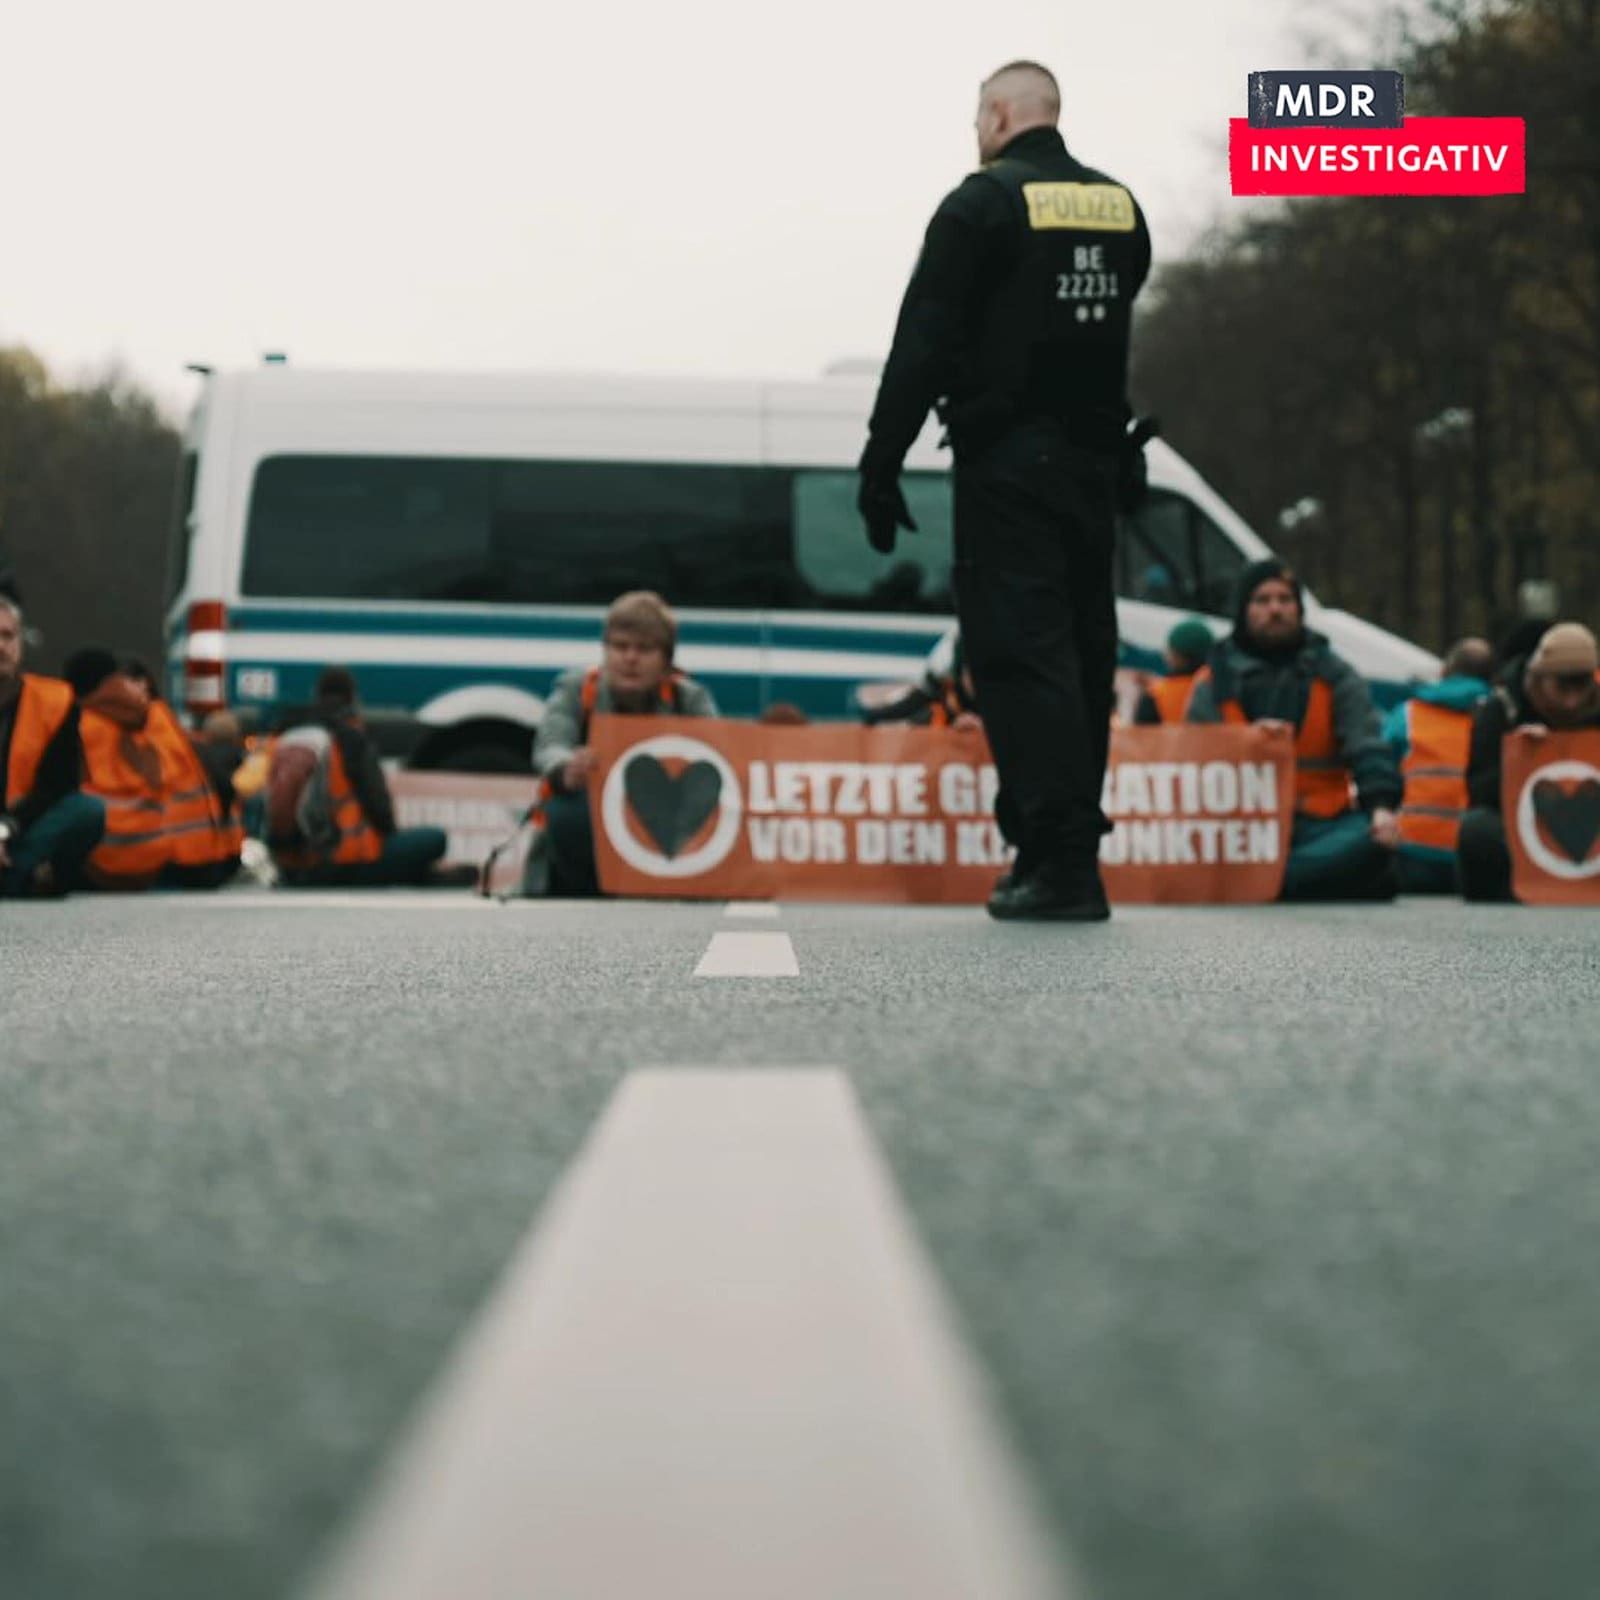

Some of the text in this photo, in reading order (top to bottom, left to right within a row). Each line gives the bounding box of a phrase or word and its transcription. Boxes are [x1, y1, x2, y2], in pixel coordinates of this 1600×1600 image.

[1074, 245, 1103, 270] BE
[749, 761, 928, 815] LETZTE
[750, 819, 847, 863] VOR
[856, 820, 946, 865] DEN
